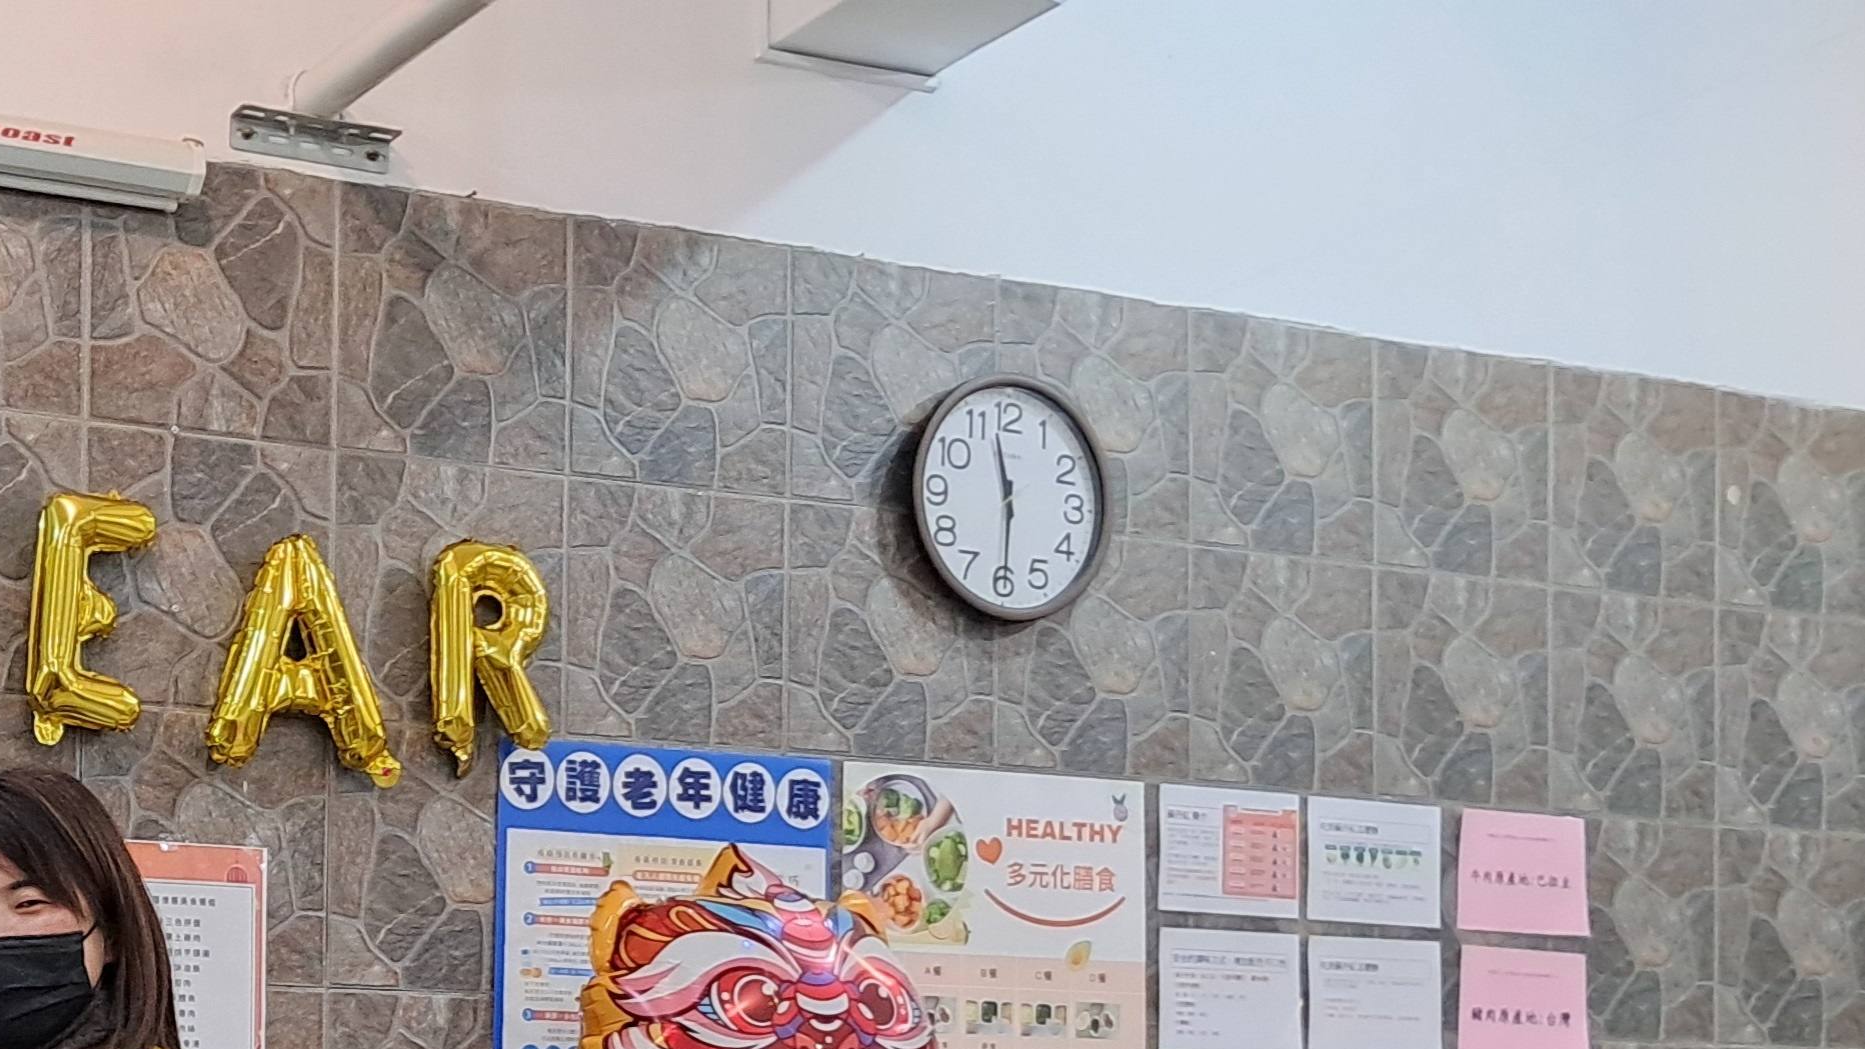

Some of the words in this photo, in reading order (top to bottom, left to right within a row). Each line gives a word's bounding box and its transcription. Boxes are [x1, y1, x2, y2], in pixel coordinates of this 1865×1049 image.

[965, 408, 986, 440] 11
[994, 401, 1023, 434] 12
[1038, 419, 1047, 449] 1
[938, 436, 971, 469] 10
[1056, 454, 1076, 486] 2
[926, 474, 948, 506] 9
[1063, 493, 1084, 525] 3
[934, 515, 957, 546] 8
[1053, 532, 1075, 562] 4
[958, 549, 981, 580] 7
[1027, 558, 1049, 590] 5
[992, 565, 1015, 597] 6
[508, 759, 822, 821] 守護老年健康
[1006, 817, 1123, 844] HEALTHY
[1007, 862, 1116, 892] 多元化膳食
